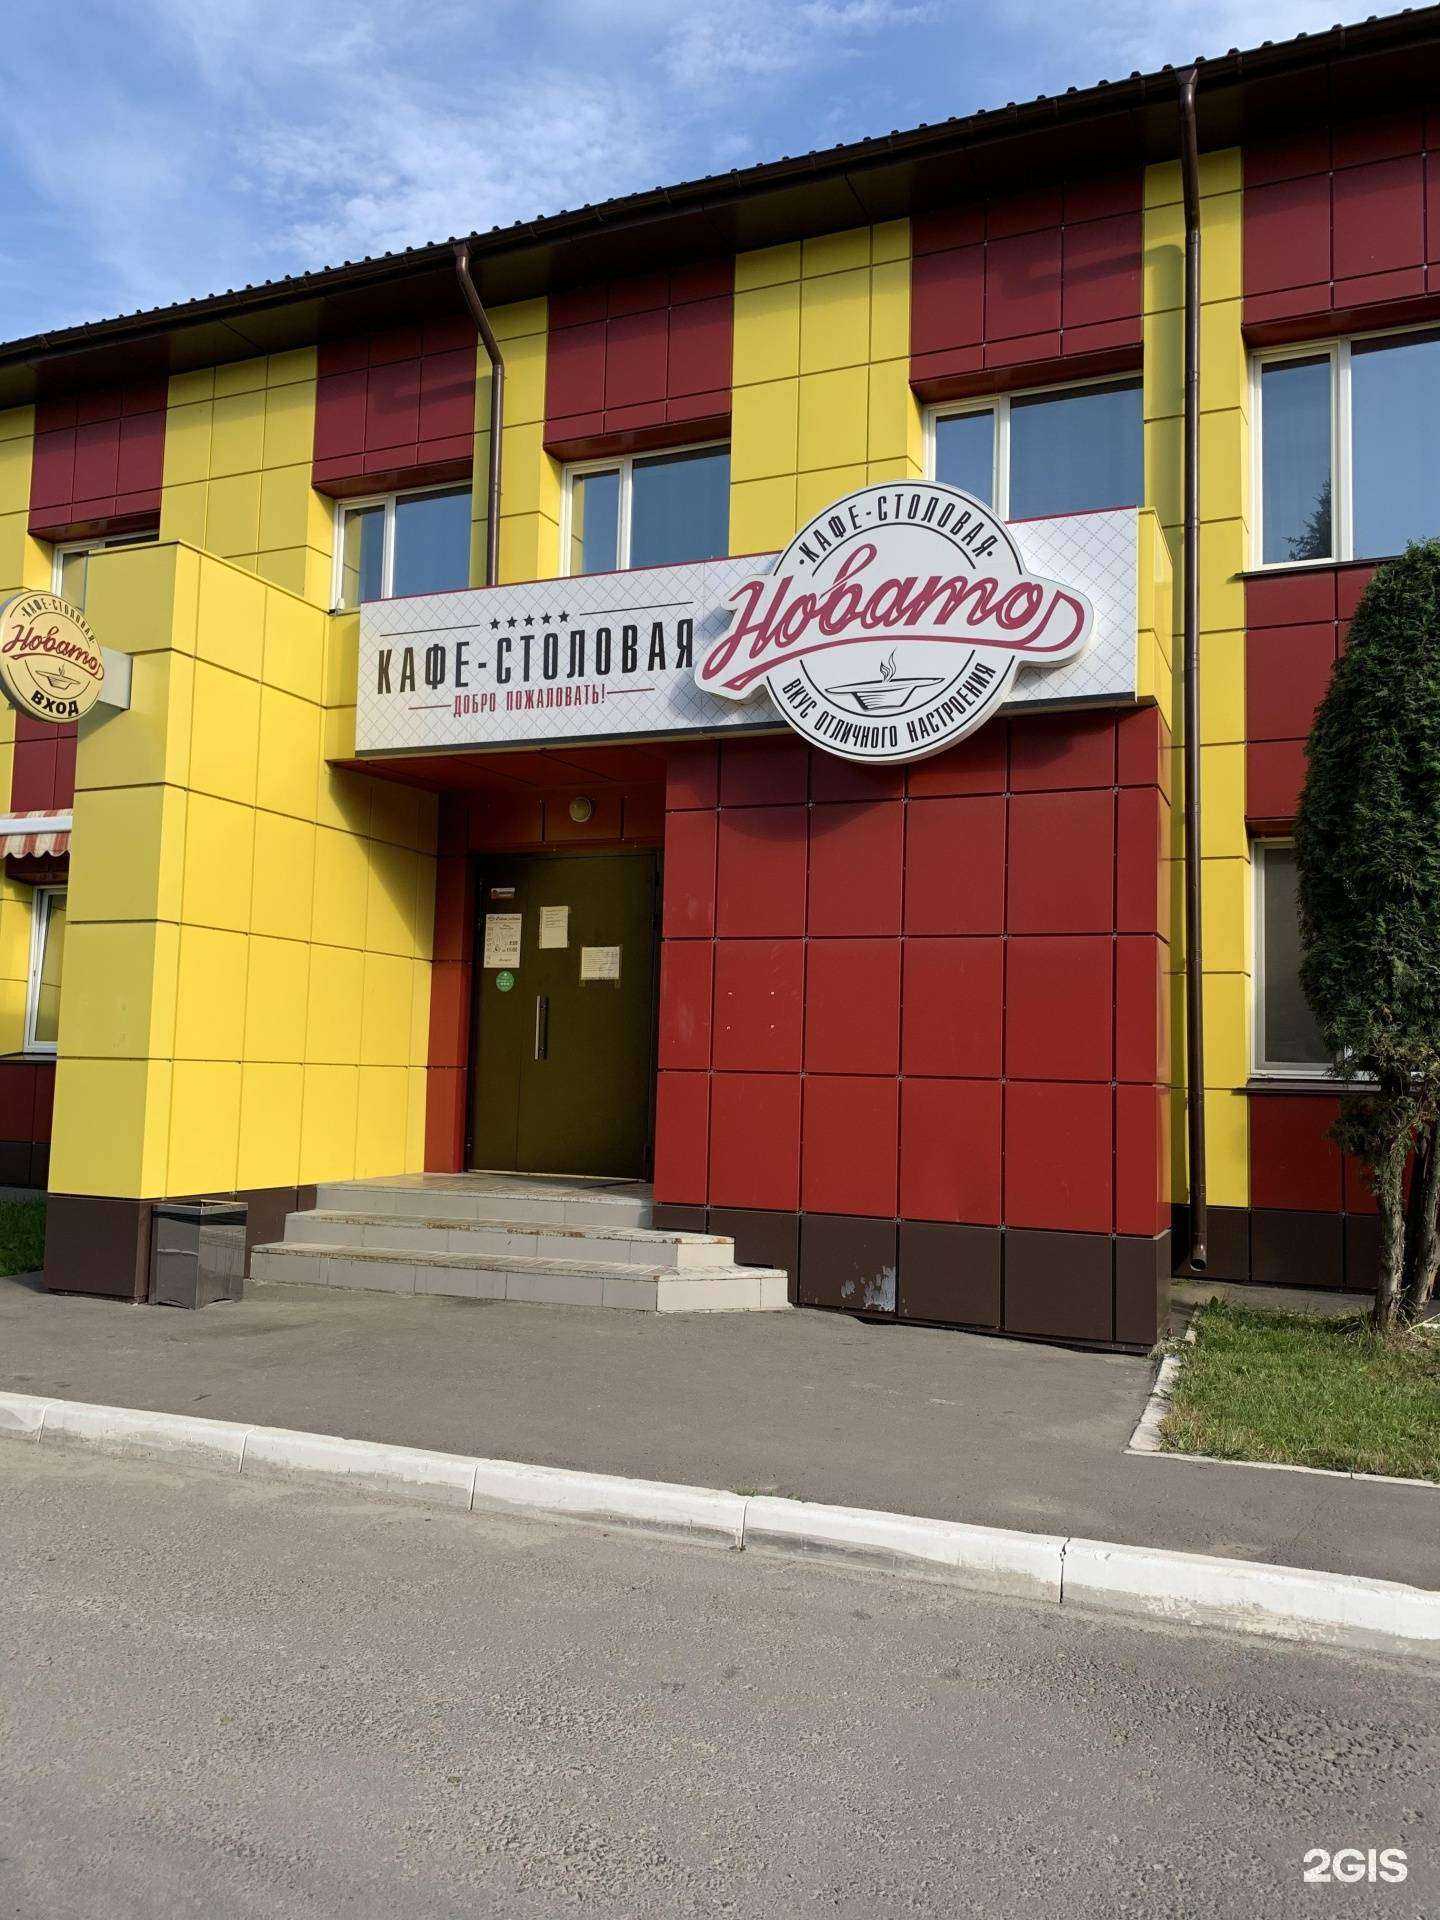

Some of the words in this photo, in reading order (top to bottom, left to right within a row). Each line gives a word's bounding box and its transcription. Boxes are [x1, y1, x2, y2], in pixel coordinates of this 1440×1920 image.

[800, 493, 997, 563] КАФЕ-СТОЛОВАЯ
[701, 543, 1085, 690] Новато
[1, 624, 104, 681] Новато
[377, 618, 694, 695] КАФЕ-СТОЛОВАЯ
[31, 690, 79, 716] ВХОД
[453, 692, 496, 718] ДОБРО
[505, 683, 606, 713] ПОЖАЛОВАТЬ!
[782, 676, 811, 720] ВКУС
[814, 710, 899, 749] ОТЛИЧНОГО
[906, 663, 997, 743] НАСТРОЕНИЯ
